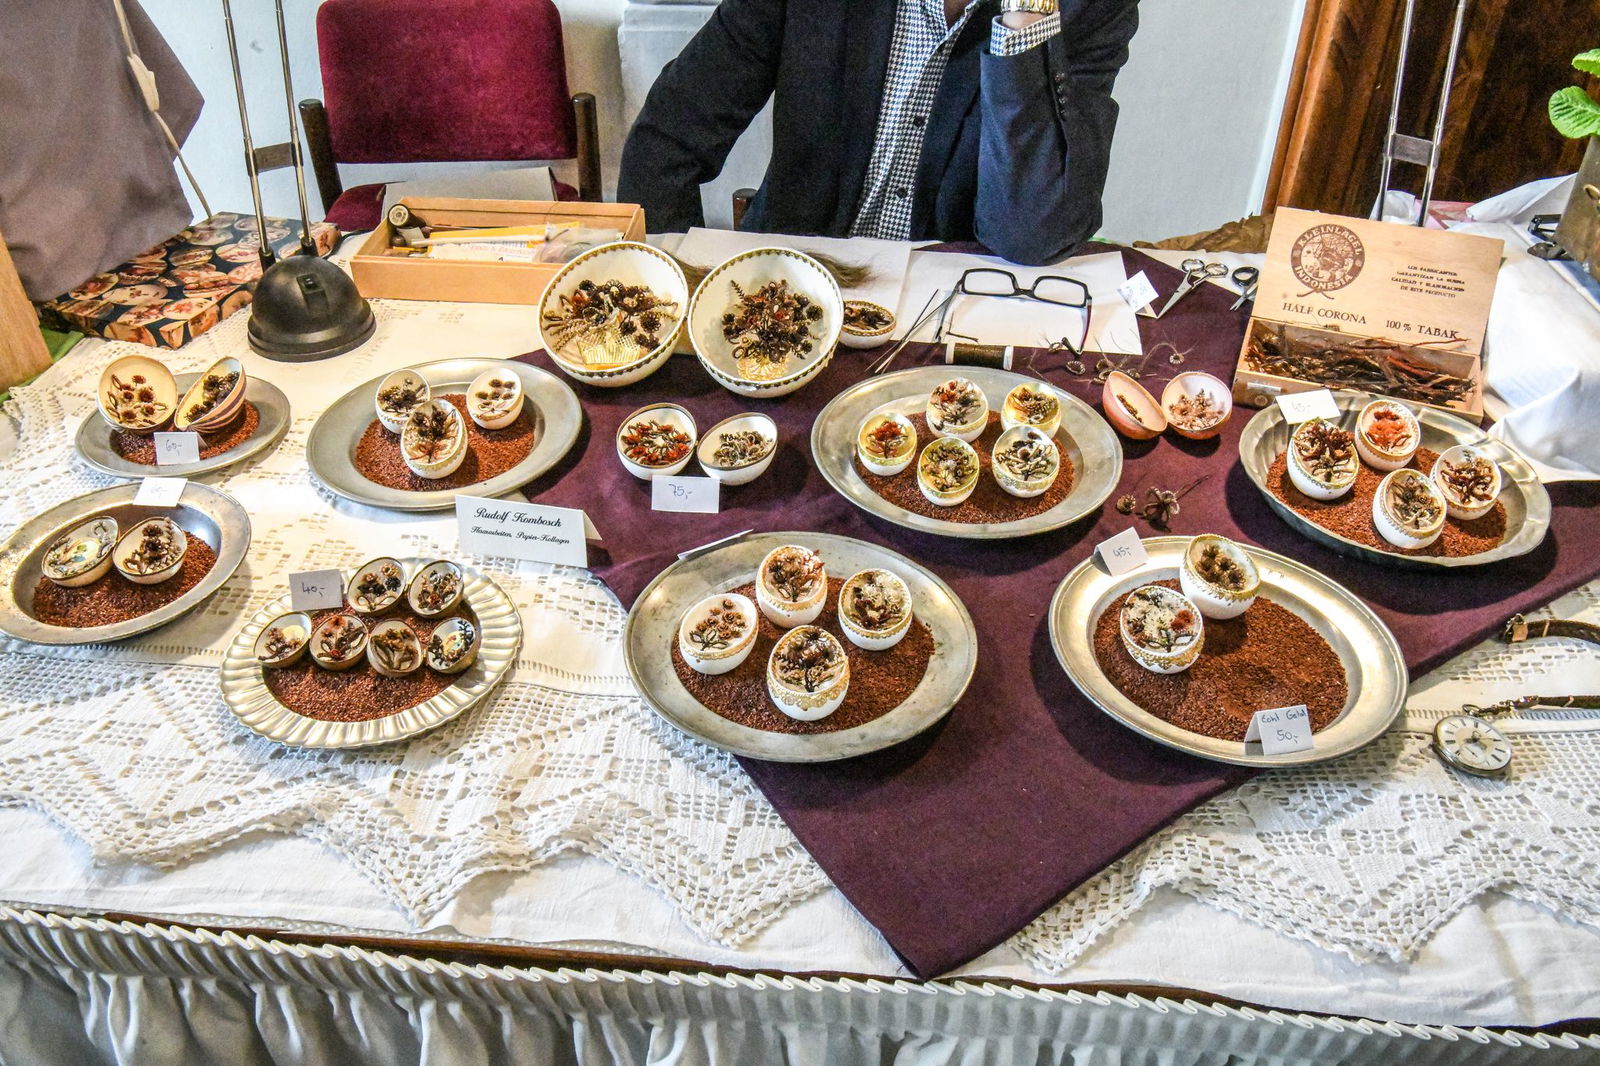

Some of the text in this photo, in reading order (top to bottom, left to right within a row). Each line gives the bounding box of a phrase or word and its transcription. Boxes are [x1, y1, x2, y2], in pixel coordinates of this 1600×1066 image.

[1298, 225, 1362, 255] KLEINLAGEL
[1295, 265, 1353, 290] INDONESIA
[1282, 302, 1367, 324] HALF CORONA
[1386, 320, 1401, 330] 100
[1417, 325, 1459, 339] TABAK
[474, 507, 562, 527] Rudolf Kombosch
[1261, 712, 1280, 723] Echt
